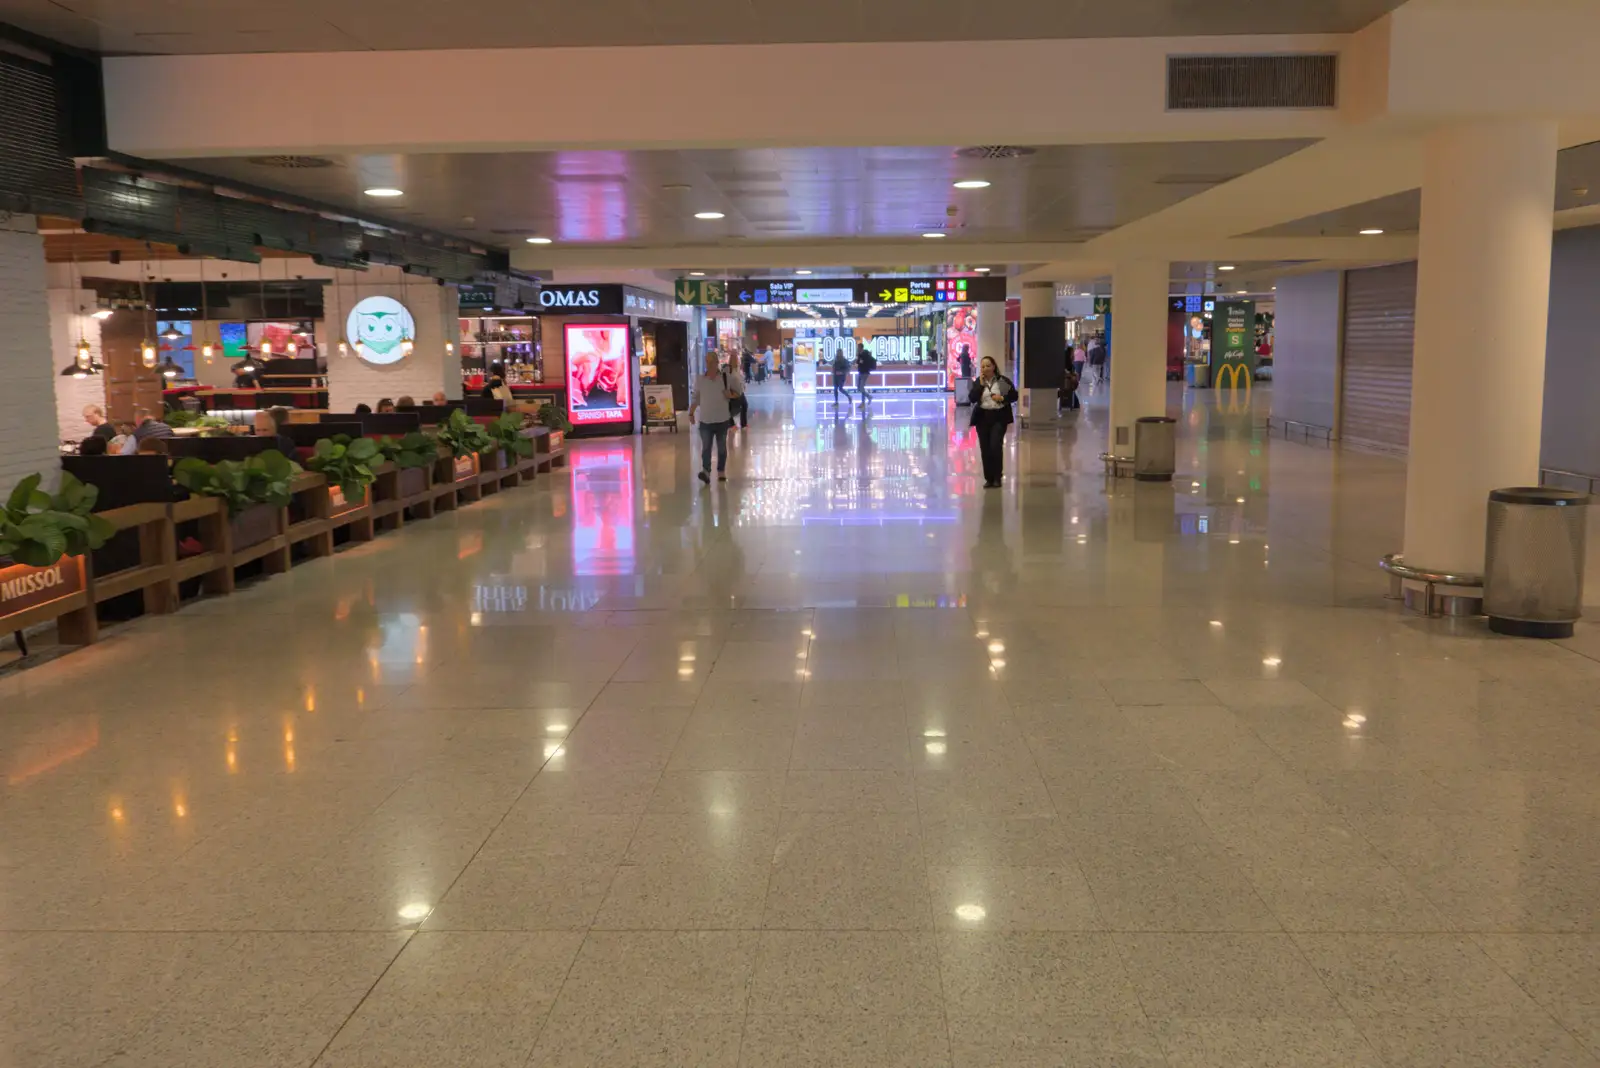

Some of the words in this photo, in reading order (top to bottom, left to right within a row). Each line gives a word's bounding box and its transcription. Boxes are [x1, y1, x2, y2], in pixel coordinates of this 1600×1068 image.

[910, 281, 930, 289] Portes
[780, 319, 829, 329] CENTRAL
[1231, 335, 1239, 345] S
[814, 336, 857, 361] FOOD
[861, 335, 930, 361] MARKET
[577, 411, 605, 421] SPANISH
[1, 566, 64, 602] MUSSOL
